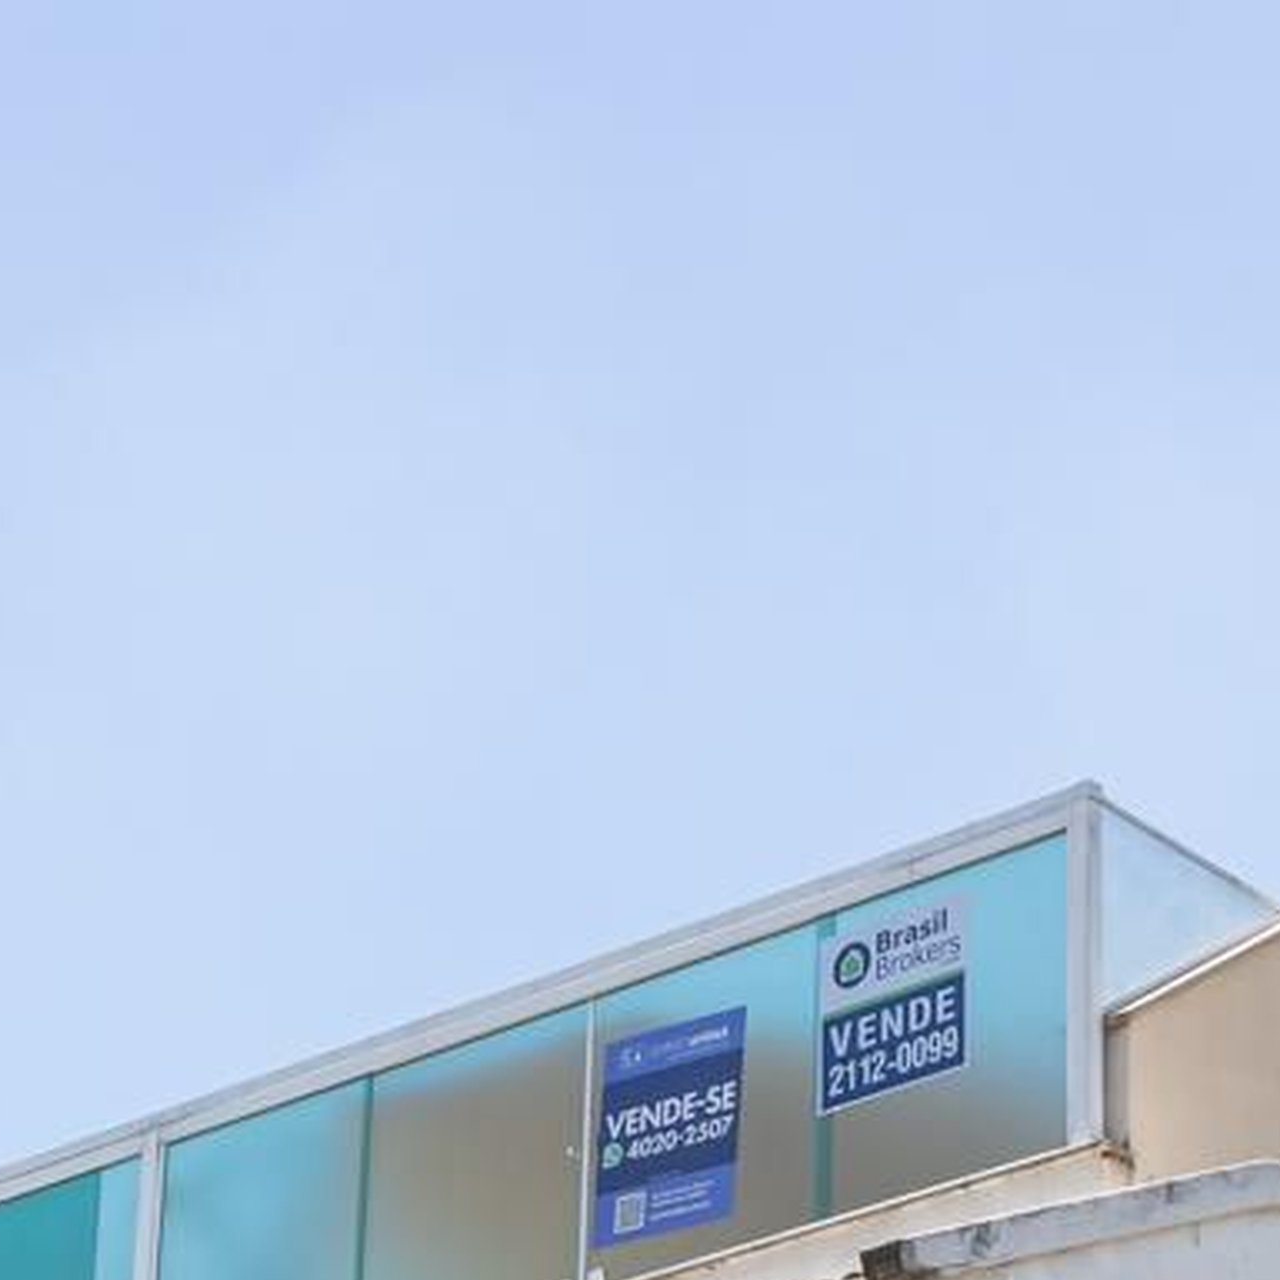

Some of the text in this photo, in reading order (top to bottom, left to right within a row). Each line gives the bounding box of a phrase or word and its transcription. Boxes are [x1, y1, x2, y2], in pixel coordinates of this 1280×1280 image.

[876, 908, 948, 953] Brasil
[876, 936, 961, 981] Brokers
[829, 986, 956, 1058] VENDE
[828, 1026, 960, 1097] 2112-0099
[606, 1080, 737, 1139] VENDE-SE
[626, 1115, 735, 1160] 4020-2507
